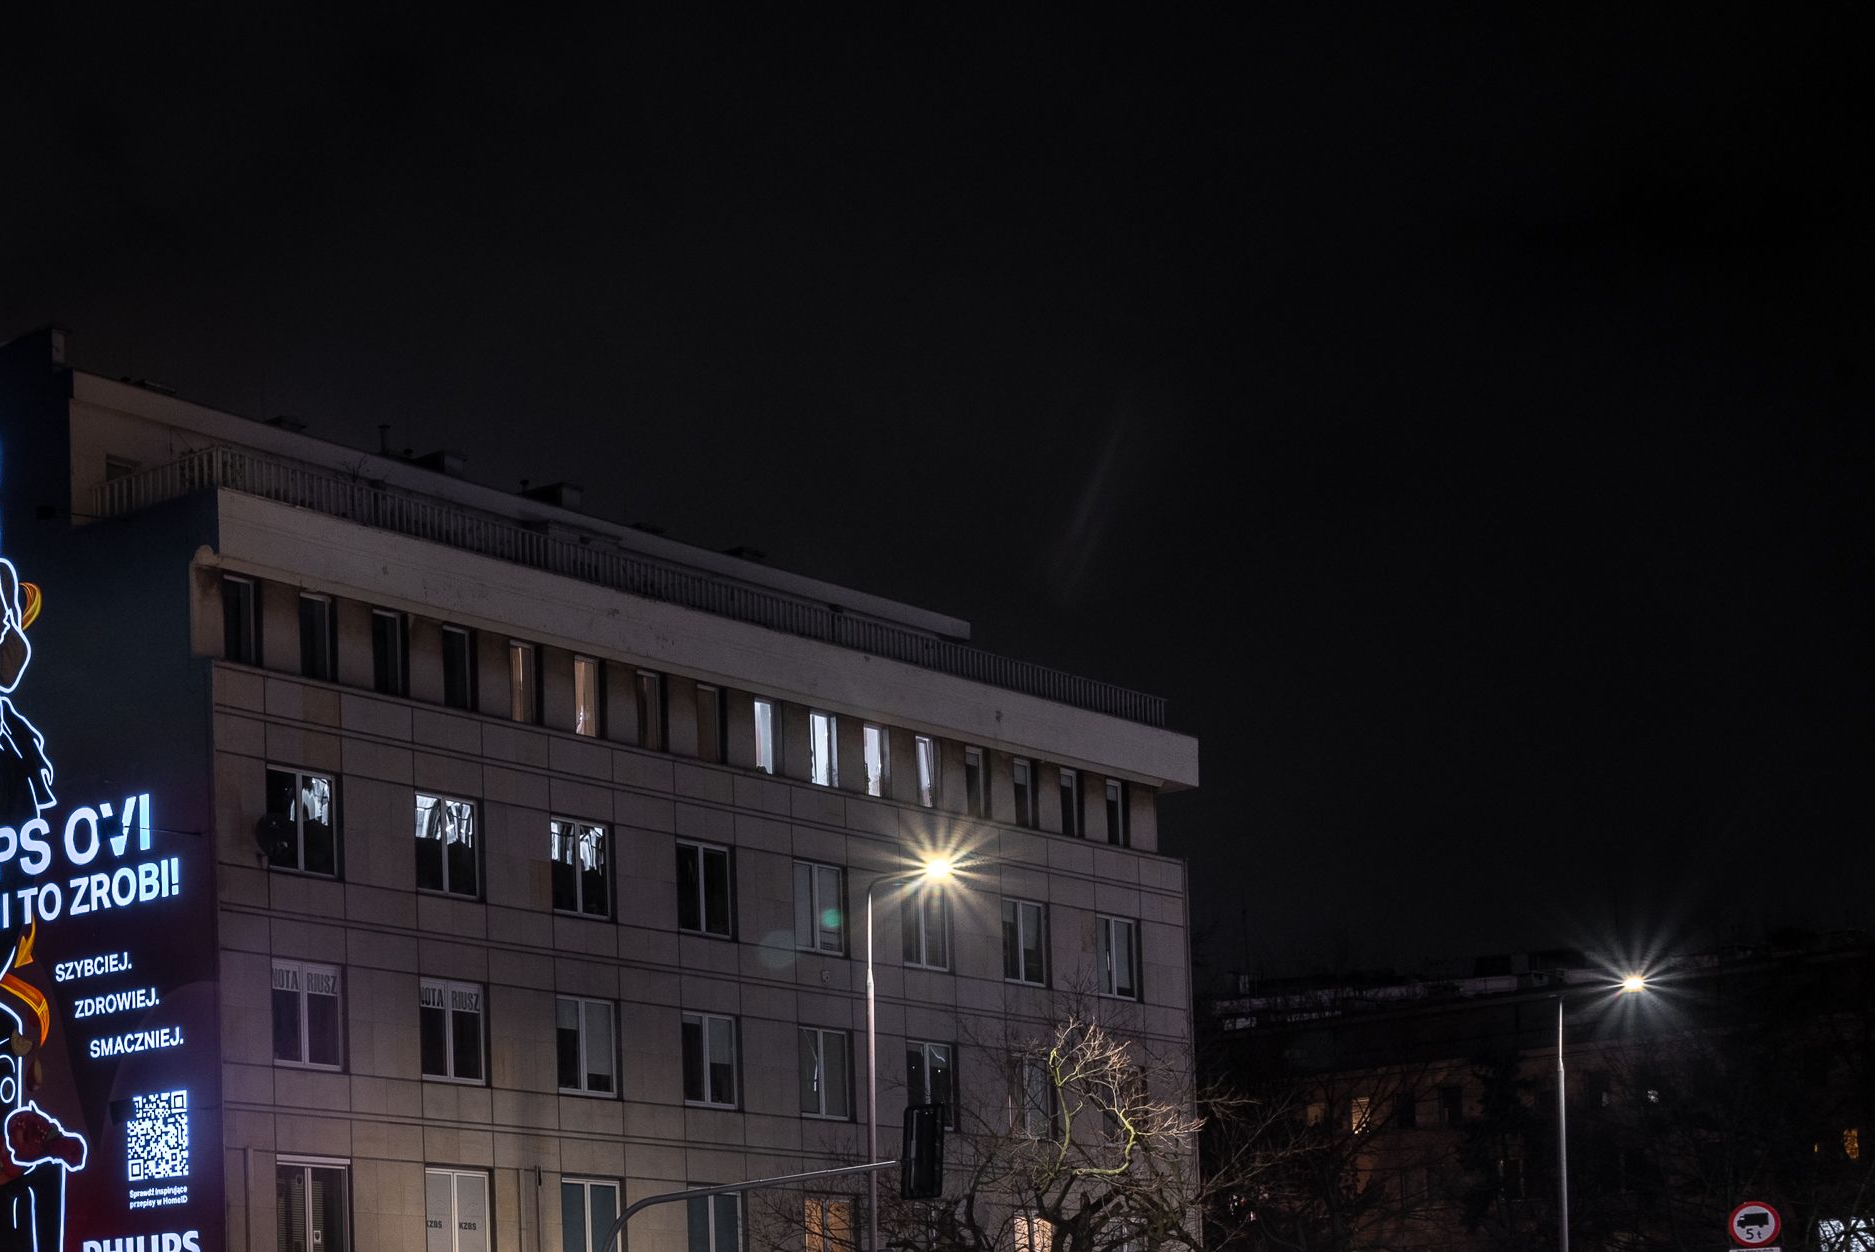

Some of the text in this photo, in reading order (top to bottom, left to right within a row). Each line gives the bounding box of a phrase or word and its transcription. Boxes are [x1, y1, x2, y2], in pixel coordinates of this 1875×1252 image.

[64, 793, 150, 865] OVI
[17, 883, 62, 924] TO
[70, 857, 180, 915] ZROBI!
[55, 952, 132, 982] SZYBCIEJ.
[75, 988, 159, 1018] ZDROWIEJ.
[90, 1026, 184, 1058] SMACZNIEJ.
[1746, 1228, 1762, 1240] 5 t
